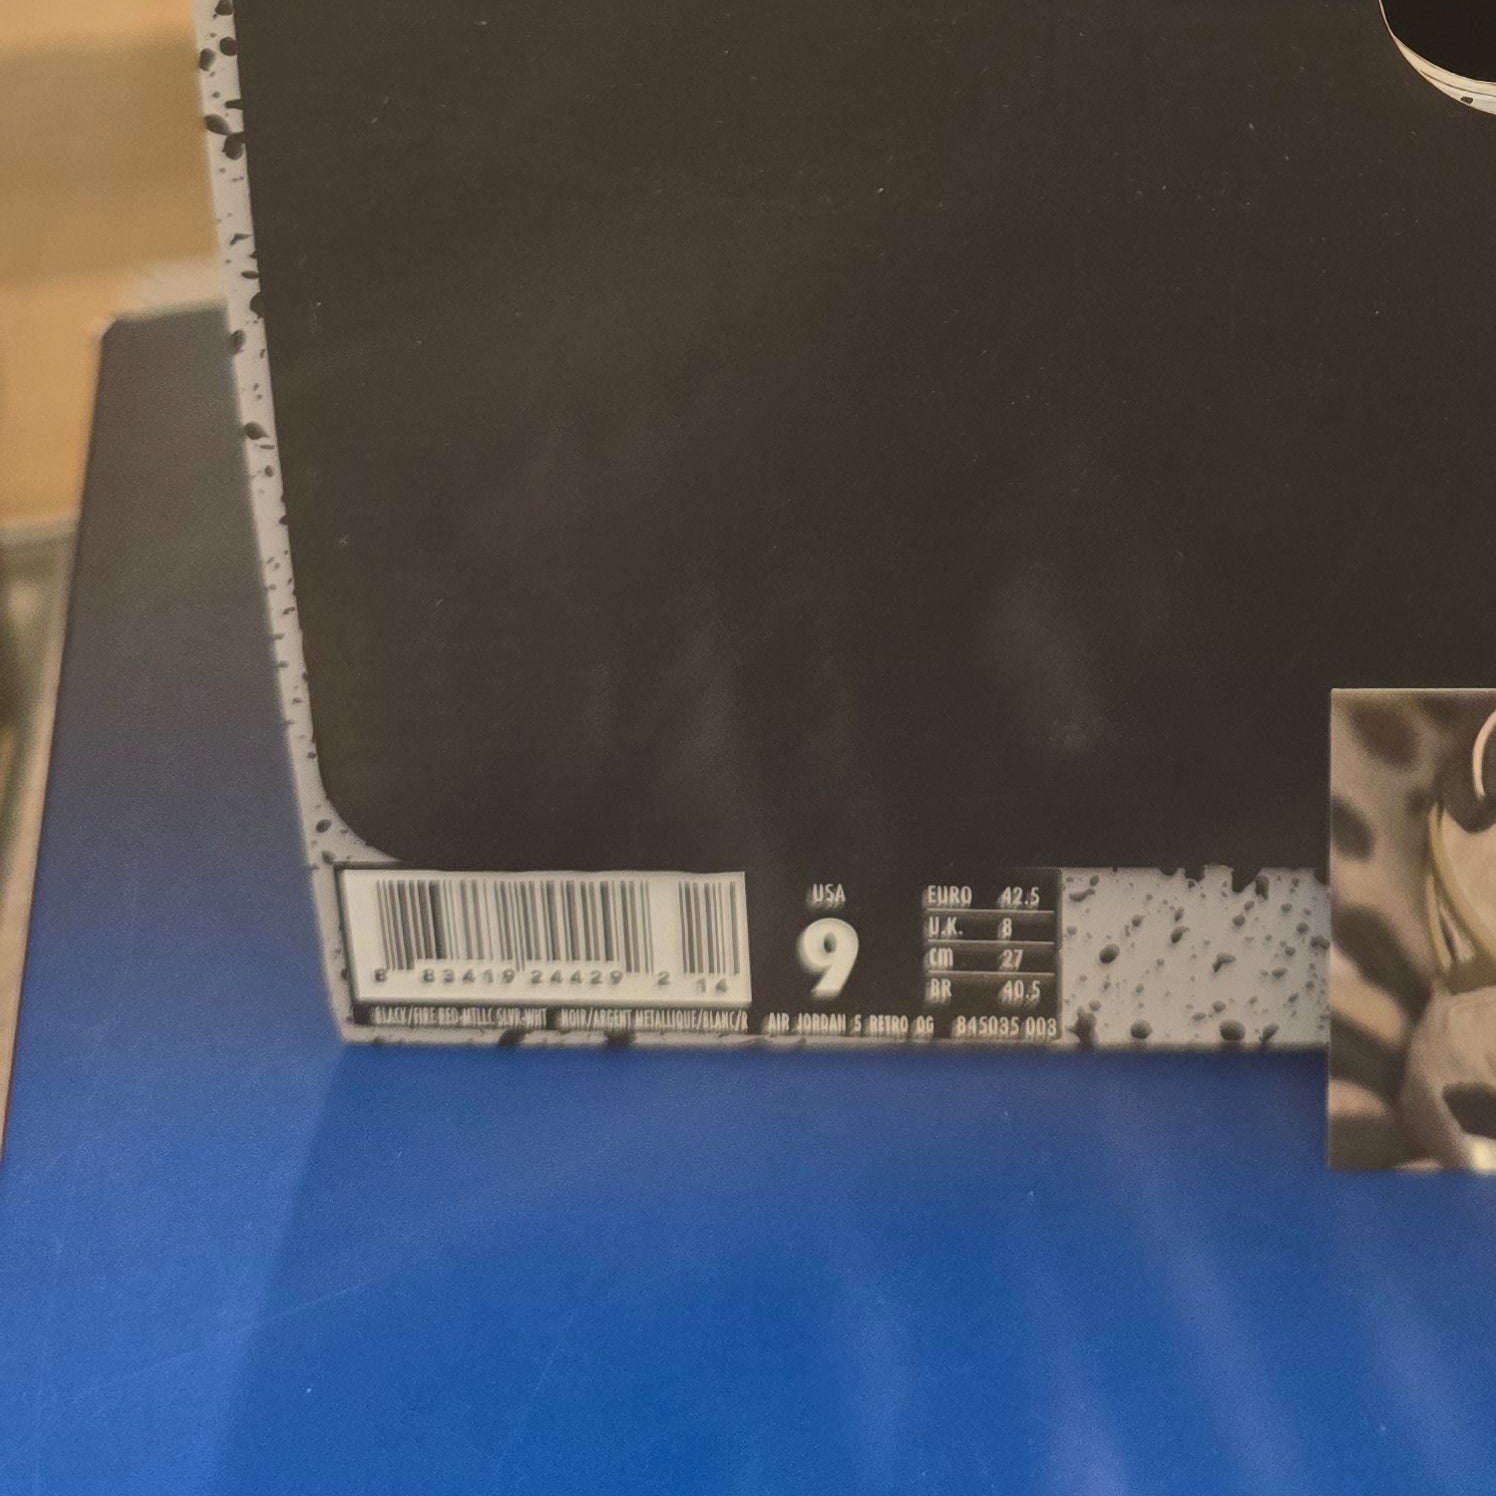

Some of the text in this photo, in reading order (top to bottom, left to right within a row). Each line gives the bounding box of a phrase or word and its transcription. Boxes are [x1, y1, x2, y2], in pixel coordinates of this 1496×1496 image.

[811, 883, 847, 905] USA
[926, 884, 1040, 906] EURO 42.5
[1000, 917, 1013, 937] 8
[801, 916, 860, 999] 9
[1002, 949, 1024, 969] 27
[930, 979, 1041, 1000] BR 40.5
[768, 1011, 790, 1033] AIR
[796, 1012, 847, 1034] JORDAN
[868, 1014, 909, 1036] RETRO
[915, 1015, 935, 1036] OG
[956, 1014, 1020, 1037] 845035
[1025, 1015, 1058, 1037] 003
